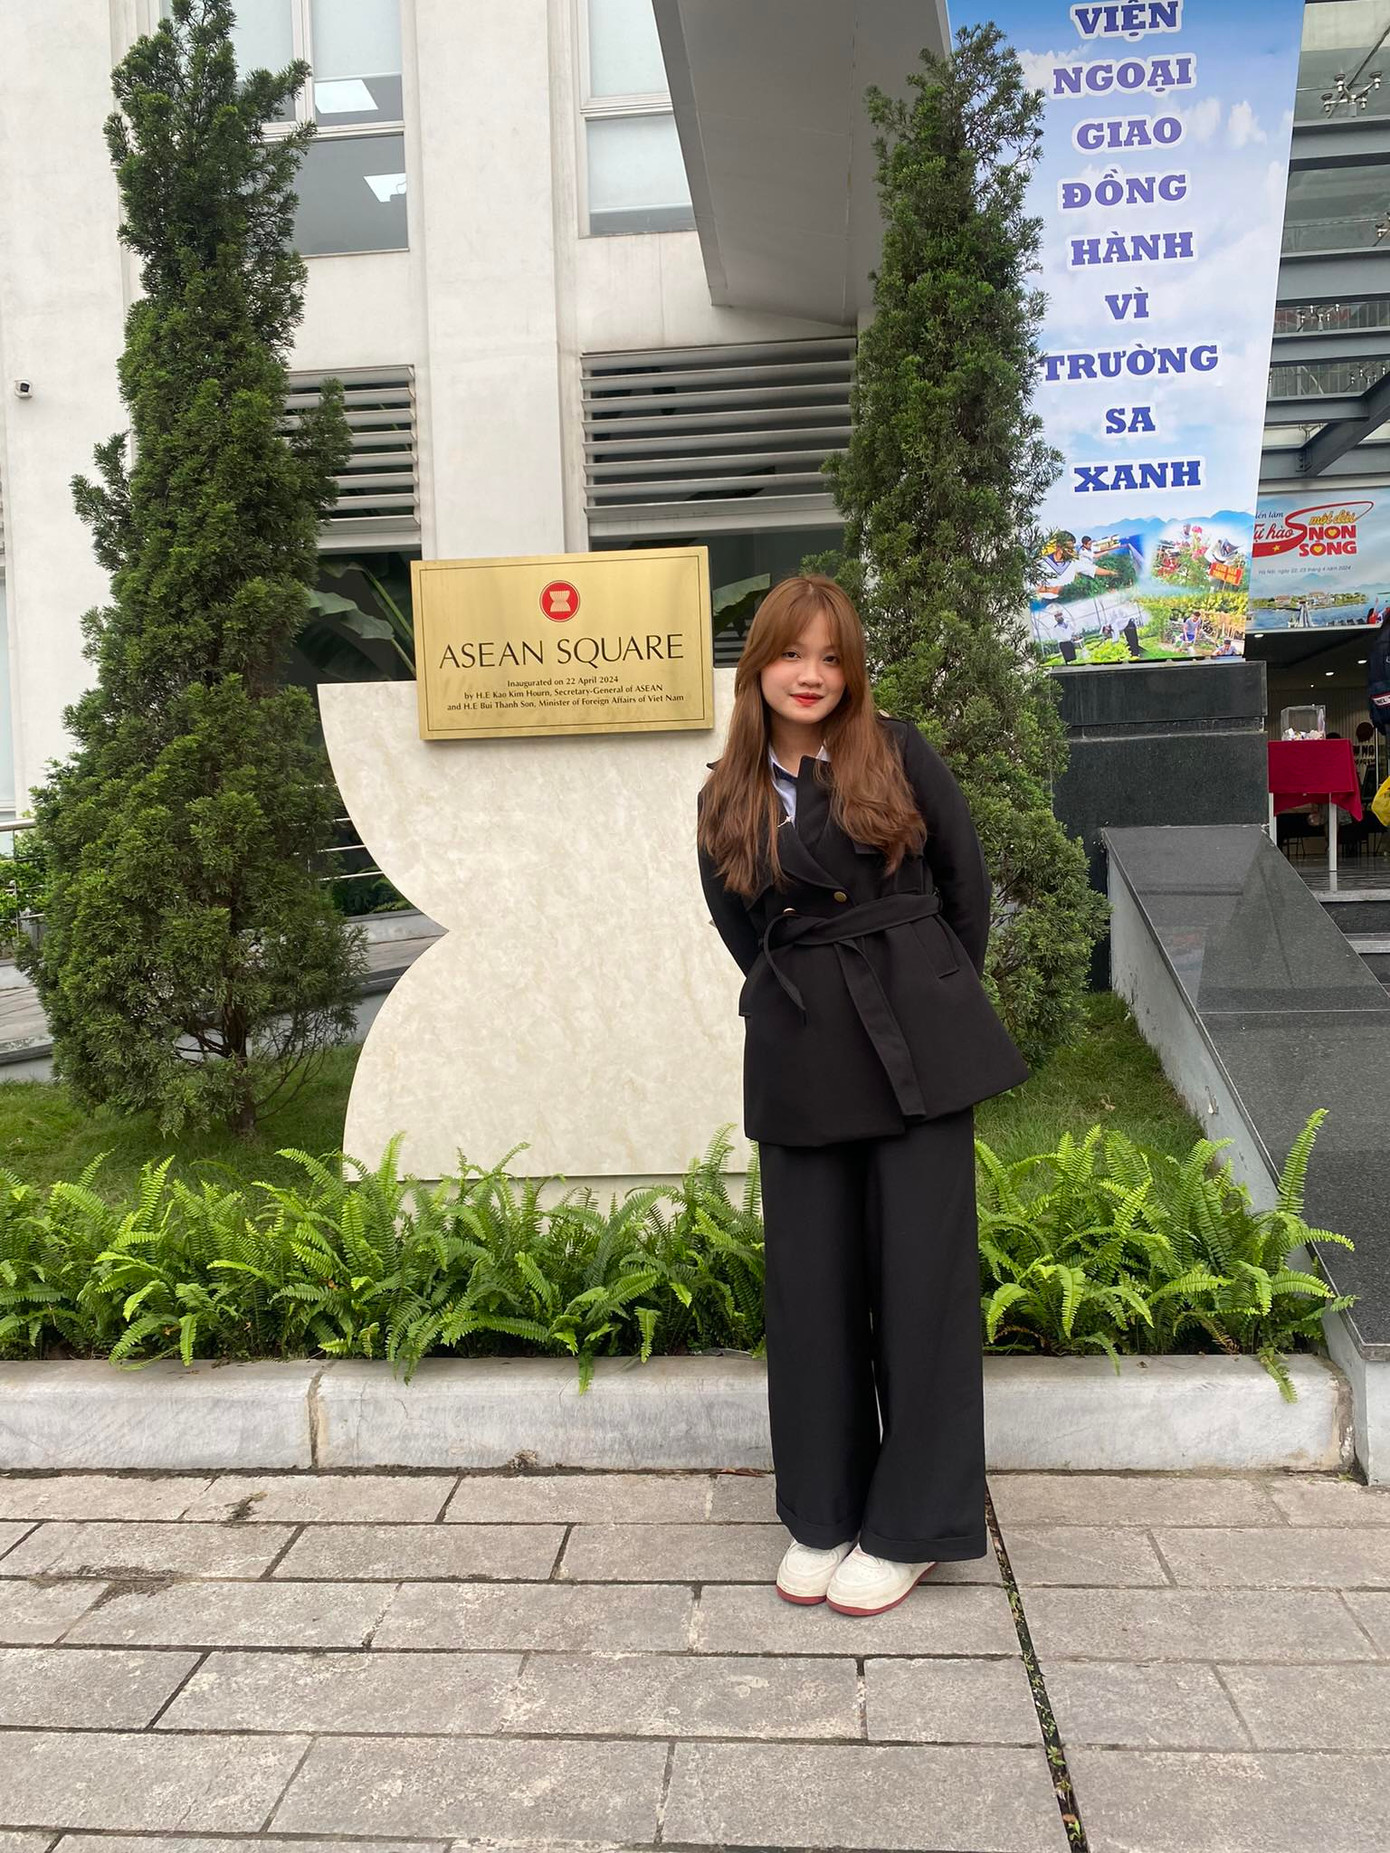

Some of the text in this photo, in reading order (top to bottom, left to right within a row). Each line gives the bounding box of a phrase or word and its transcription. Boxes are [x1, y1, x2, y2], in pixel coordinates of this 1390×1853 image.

[1075, 0, 1178, 37] VIỆN
[1053, 58, 1192, 95] NGOẠI
[1077, 117, 1182, 150] GIAO
[1062, 169, 1187, 209] ĐỒNG
[1071, 231, 1193, 266] HÀNH
[1105, 287, 1149, 320] VÌ
[1039, 343, 1219, 381] TRƯỜNG
[1105, 406, 1156, 434] SA
[1074, 460, 1201, 493] XANH
[1265, 522, 1294, 540] hào
[1309, 525, 1357, 540] NON
[439, 633, 684, 669] ASEAN SQUARE
[464, 684, 663, 700] by H.E Kao Kim Hourn, Secretary-General of ASEAN
[507, 678, 552, 688] Inaugurated
[566, 677, 576, 685] 22
[578, 676, 597, 686] April
[599, 675, 619, 684] 2024
[447, 694, 684, 711] and H.E Bui Thanh Son, Minister of Foreign Affairs of Viet Nam
